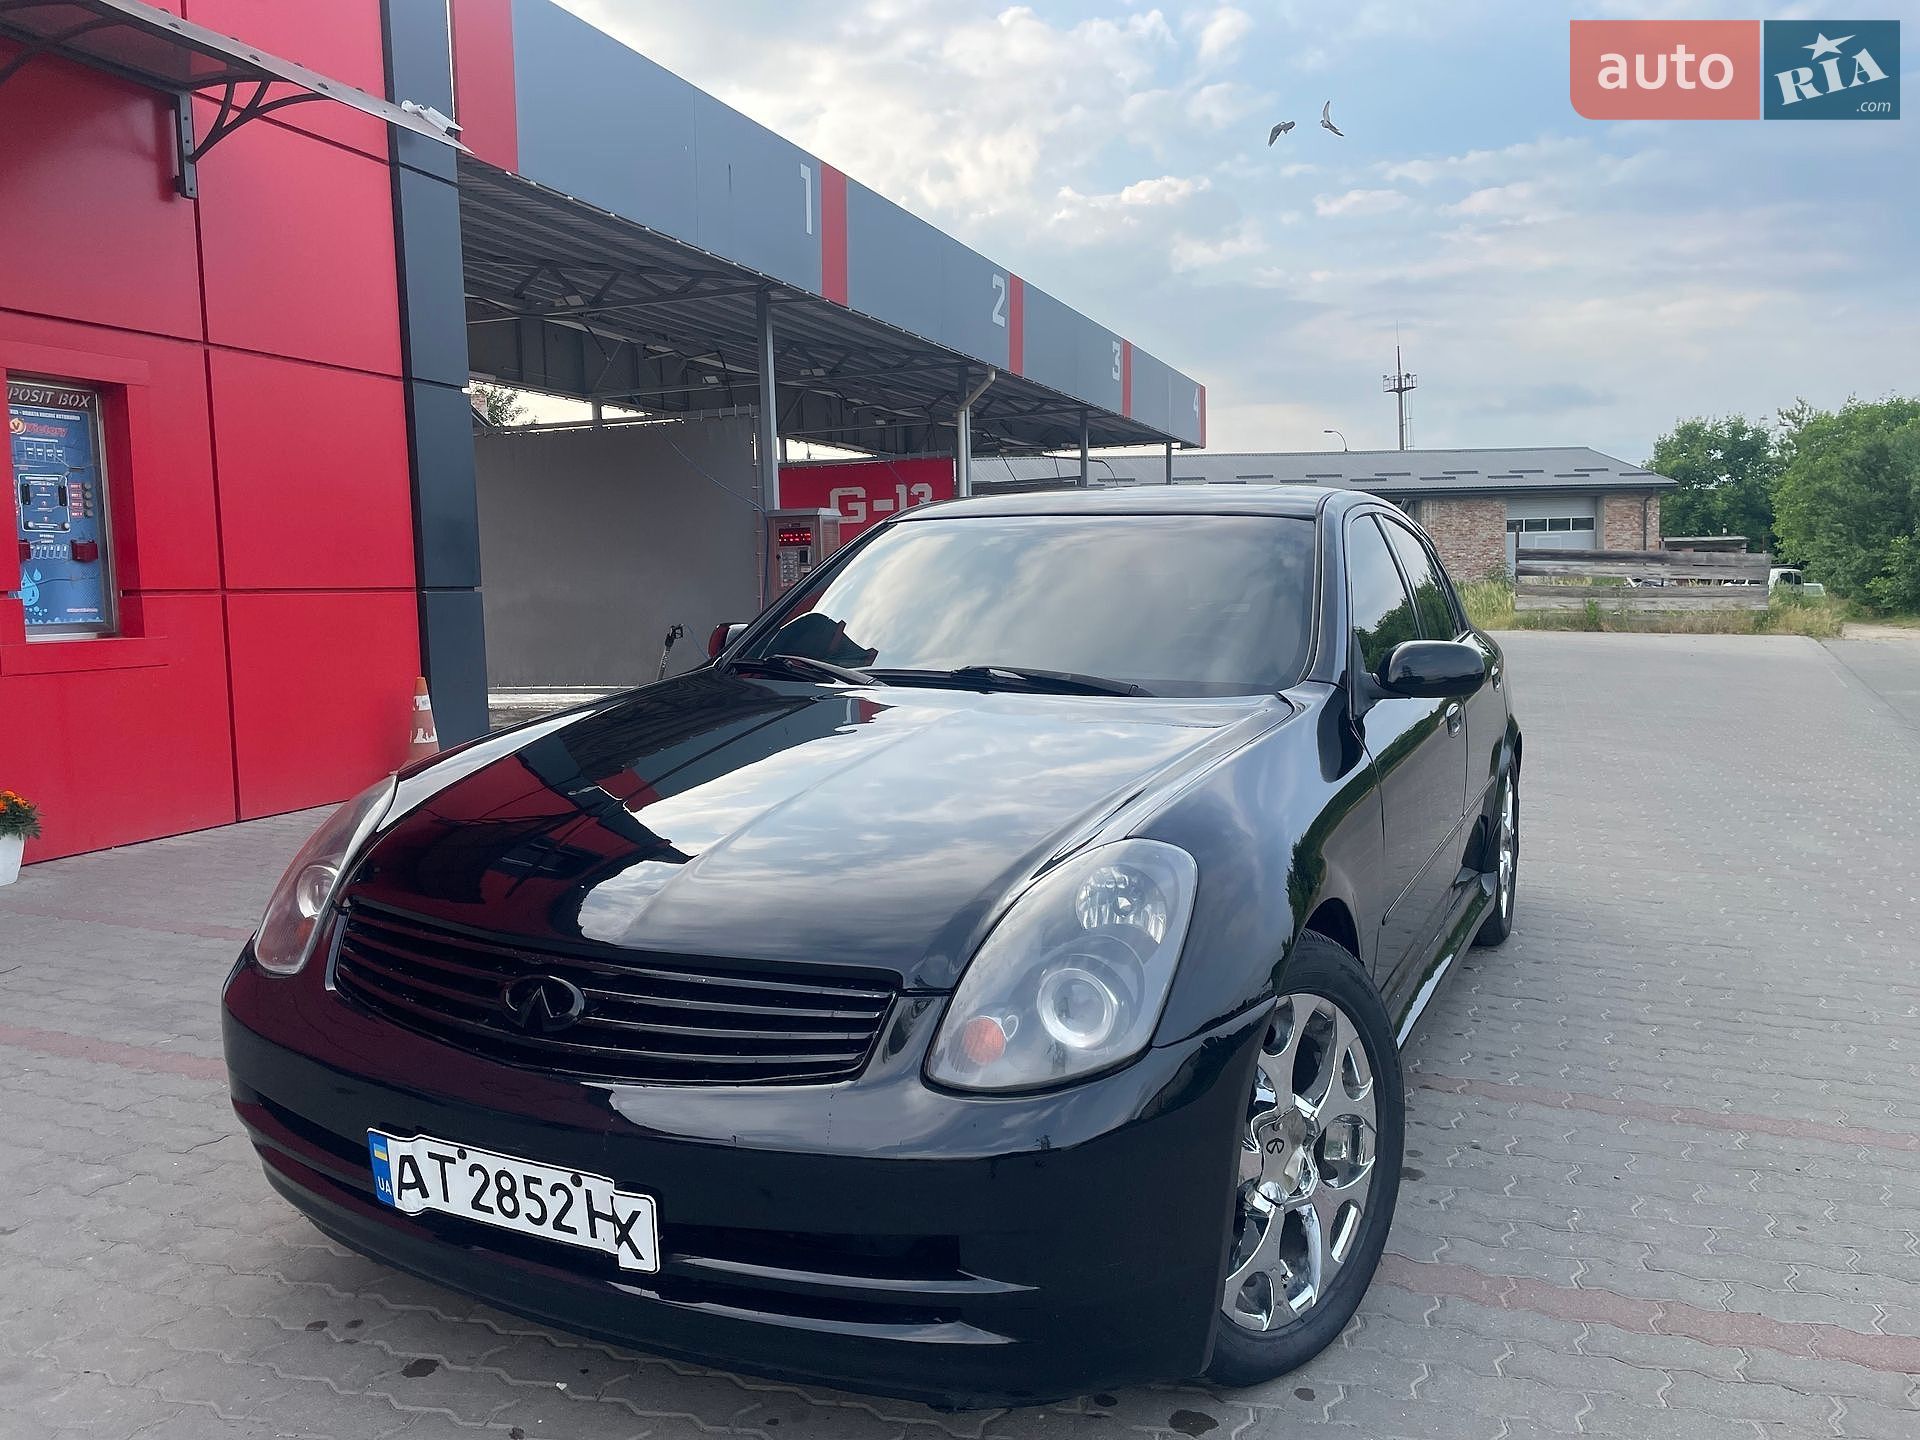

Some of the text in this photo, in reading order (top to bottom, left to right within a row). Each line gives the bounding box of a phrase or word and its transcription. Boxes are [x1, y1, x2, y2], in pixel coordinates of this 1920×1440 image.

[800, 163, 813, 235] 1
[992, 273, 1007, 328] 2
[1111, 340, 1122, 382] 3
[58, 393, 91, 408] BOX
[1193, 387, 1199, 420] 4
[377, 1174, 392, 1197] UA
[397, 1151, 645, 1261] AT 2852 HX
